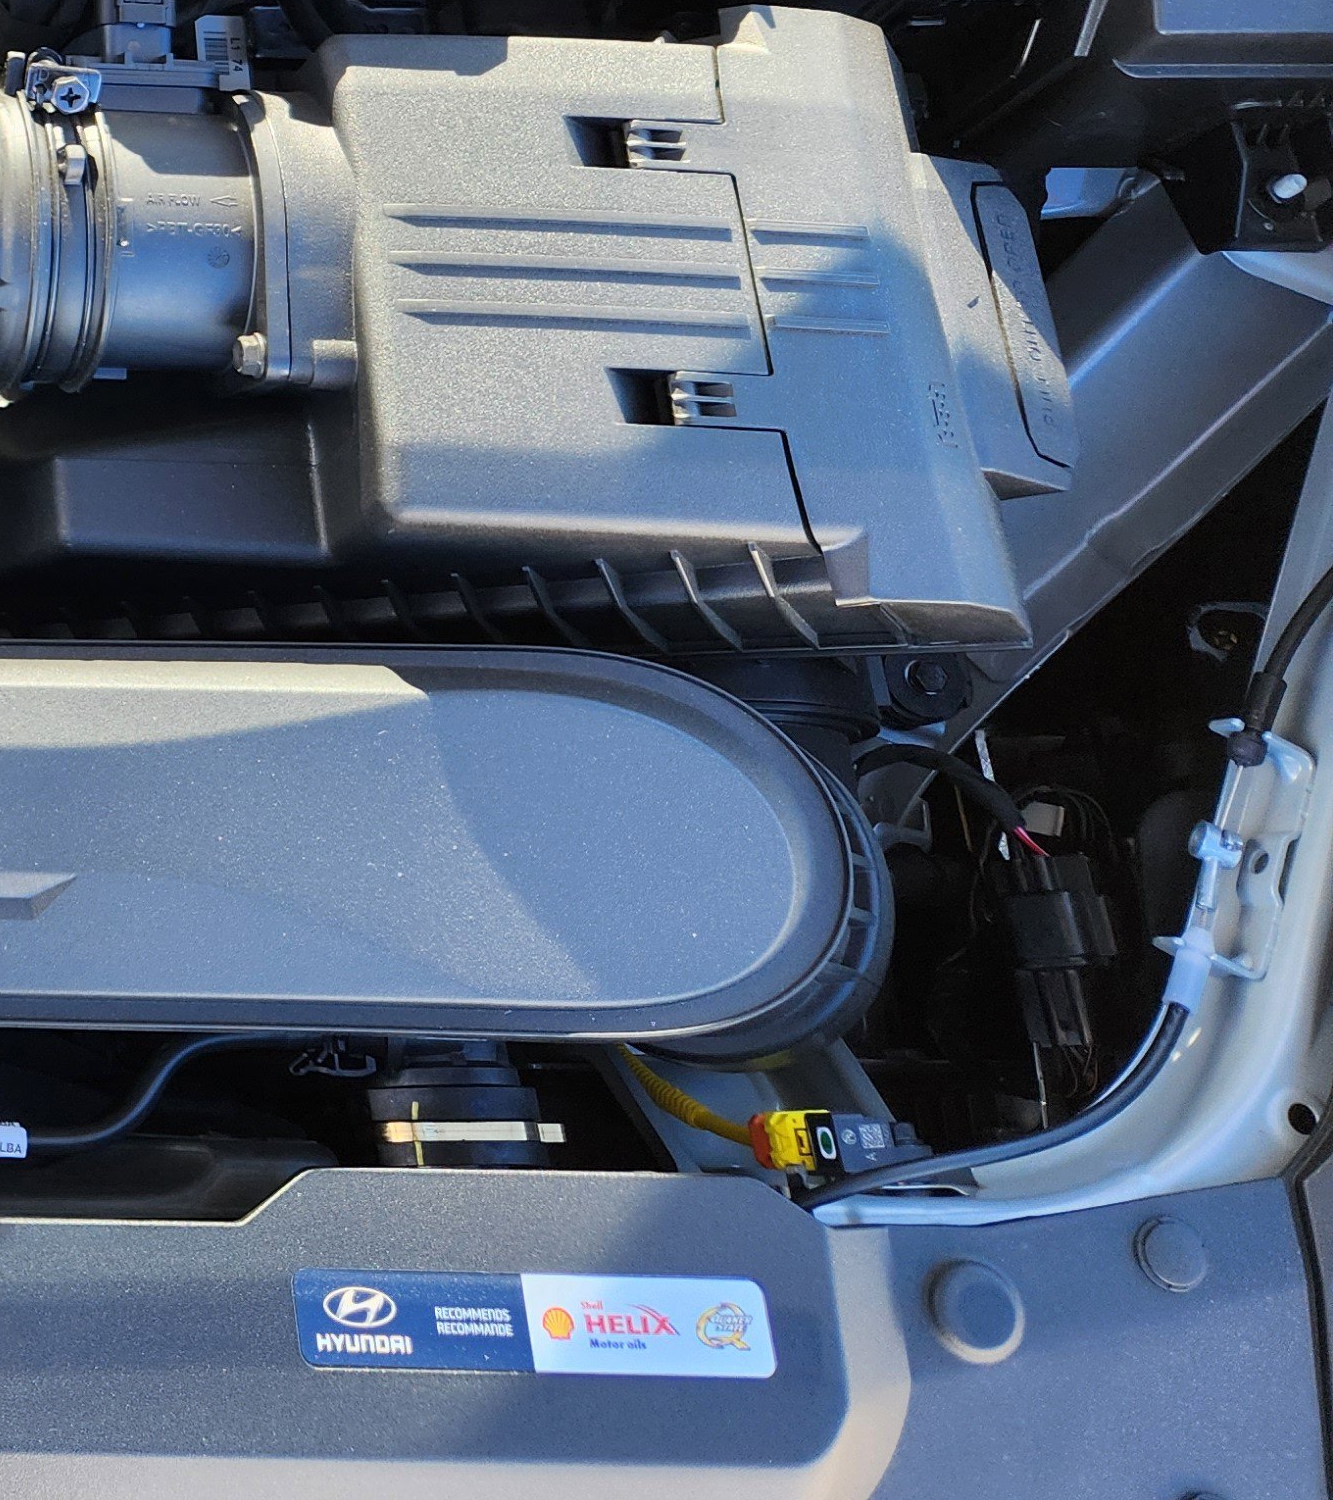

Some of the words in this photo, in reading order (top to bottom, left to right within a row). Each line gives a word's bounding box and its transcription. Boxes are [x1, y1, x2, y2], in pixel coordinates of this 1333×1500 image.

[146, 192, 166, 208] AIR
[168, 192, 201, 208] FLOW
[0, 1141, 22, 1154] LBA
[580, 1300, 604, 1311] Shell
[434, 1306, 512, 1322] RECOMMENDS
[436, 1321, 514, 1338] RECOMMANDE
[584, 1313, 677, 1336] HELIX
[316, 1332, 414, 1355] HYUNDAI
[589, 1338, 625, 1350] Motor
[627, 1338, 648, 1350] oils
